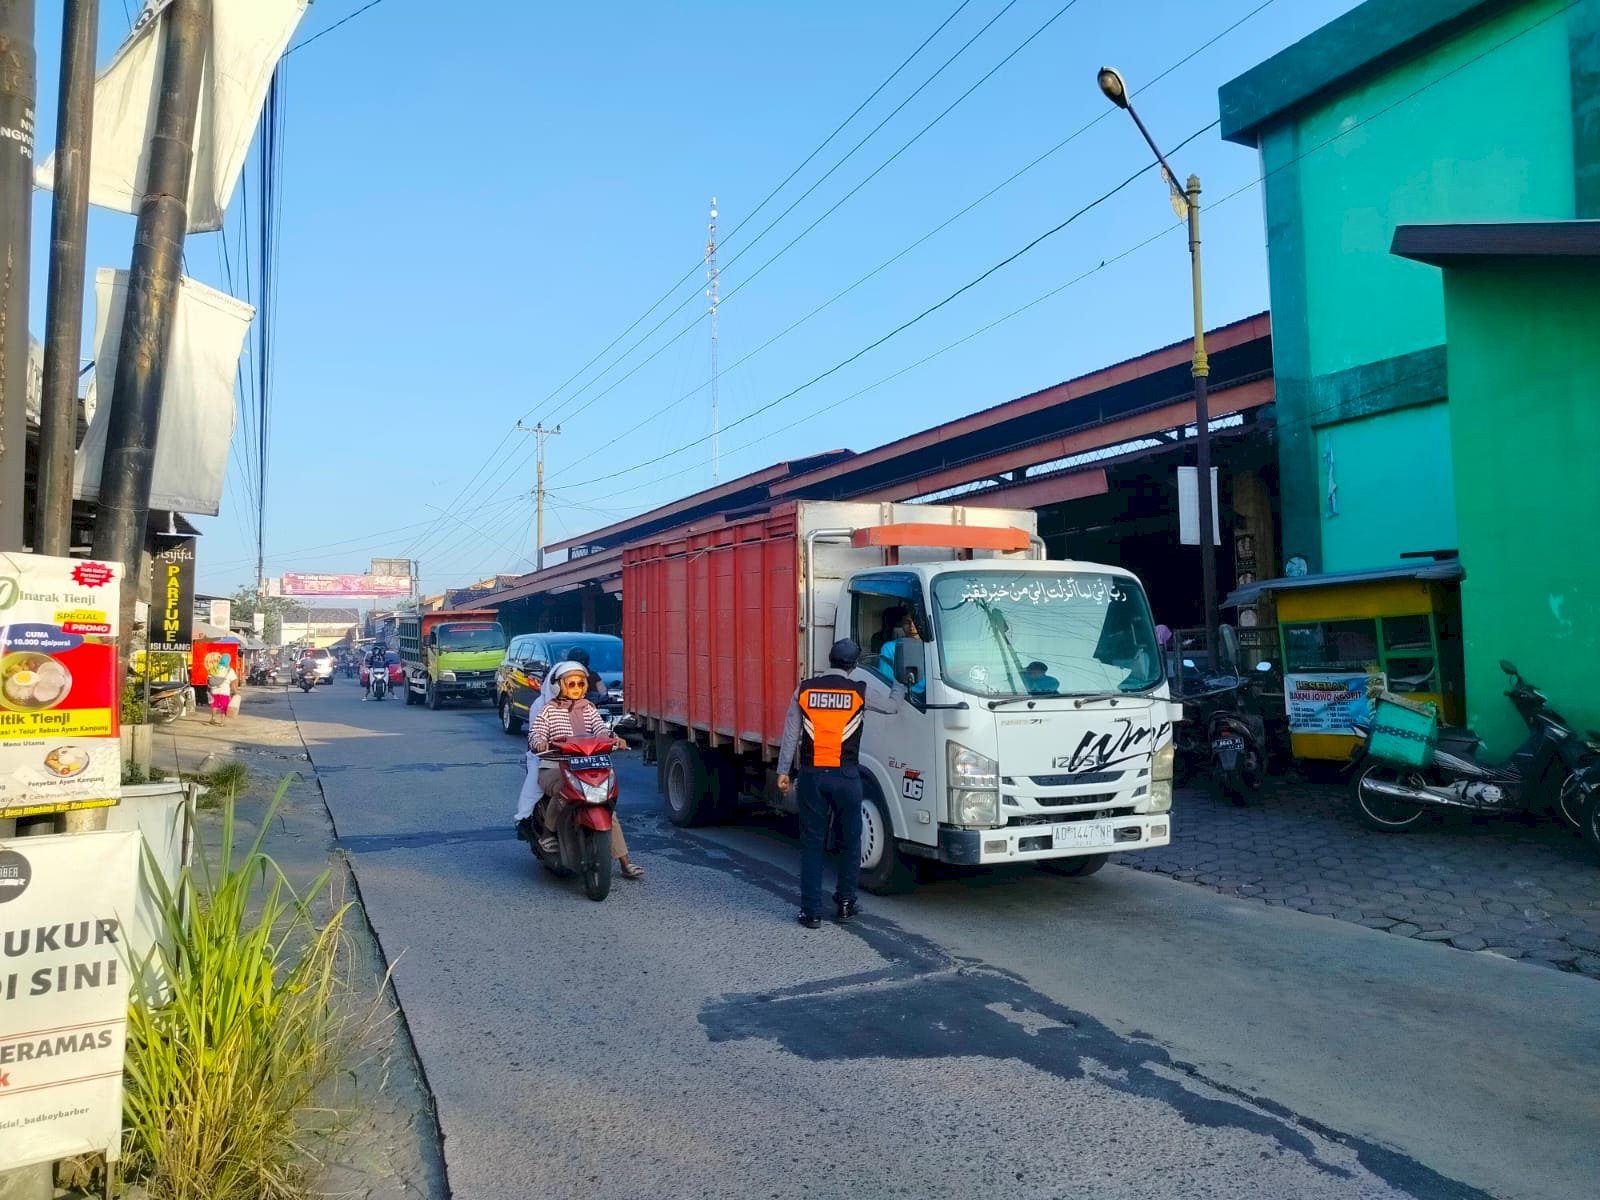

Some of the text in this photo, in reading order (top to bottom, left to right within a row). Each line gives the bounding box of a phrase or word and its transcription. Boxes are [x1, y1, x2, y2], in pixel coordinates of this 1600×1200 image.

[163, 565, 181, 641] PARFUME
[57, 612, 98, 621] SPECIAL
[72, 623, 109, 632] PROMO
[150, 642, 191, 651] ISI ULANG
[809, 692, 852, 709] DISHUB
[889, 760, 906, 769] ELF
[1, 918, 119, 957] UKUR
[30, 960, 117, 996] SINI
[0, 1029, 112, 1065] ERAMAS
